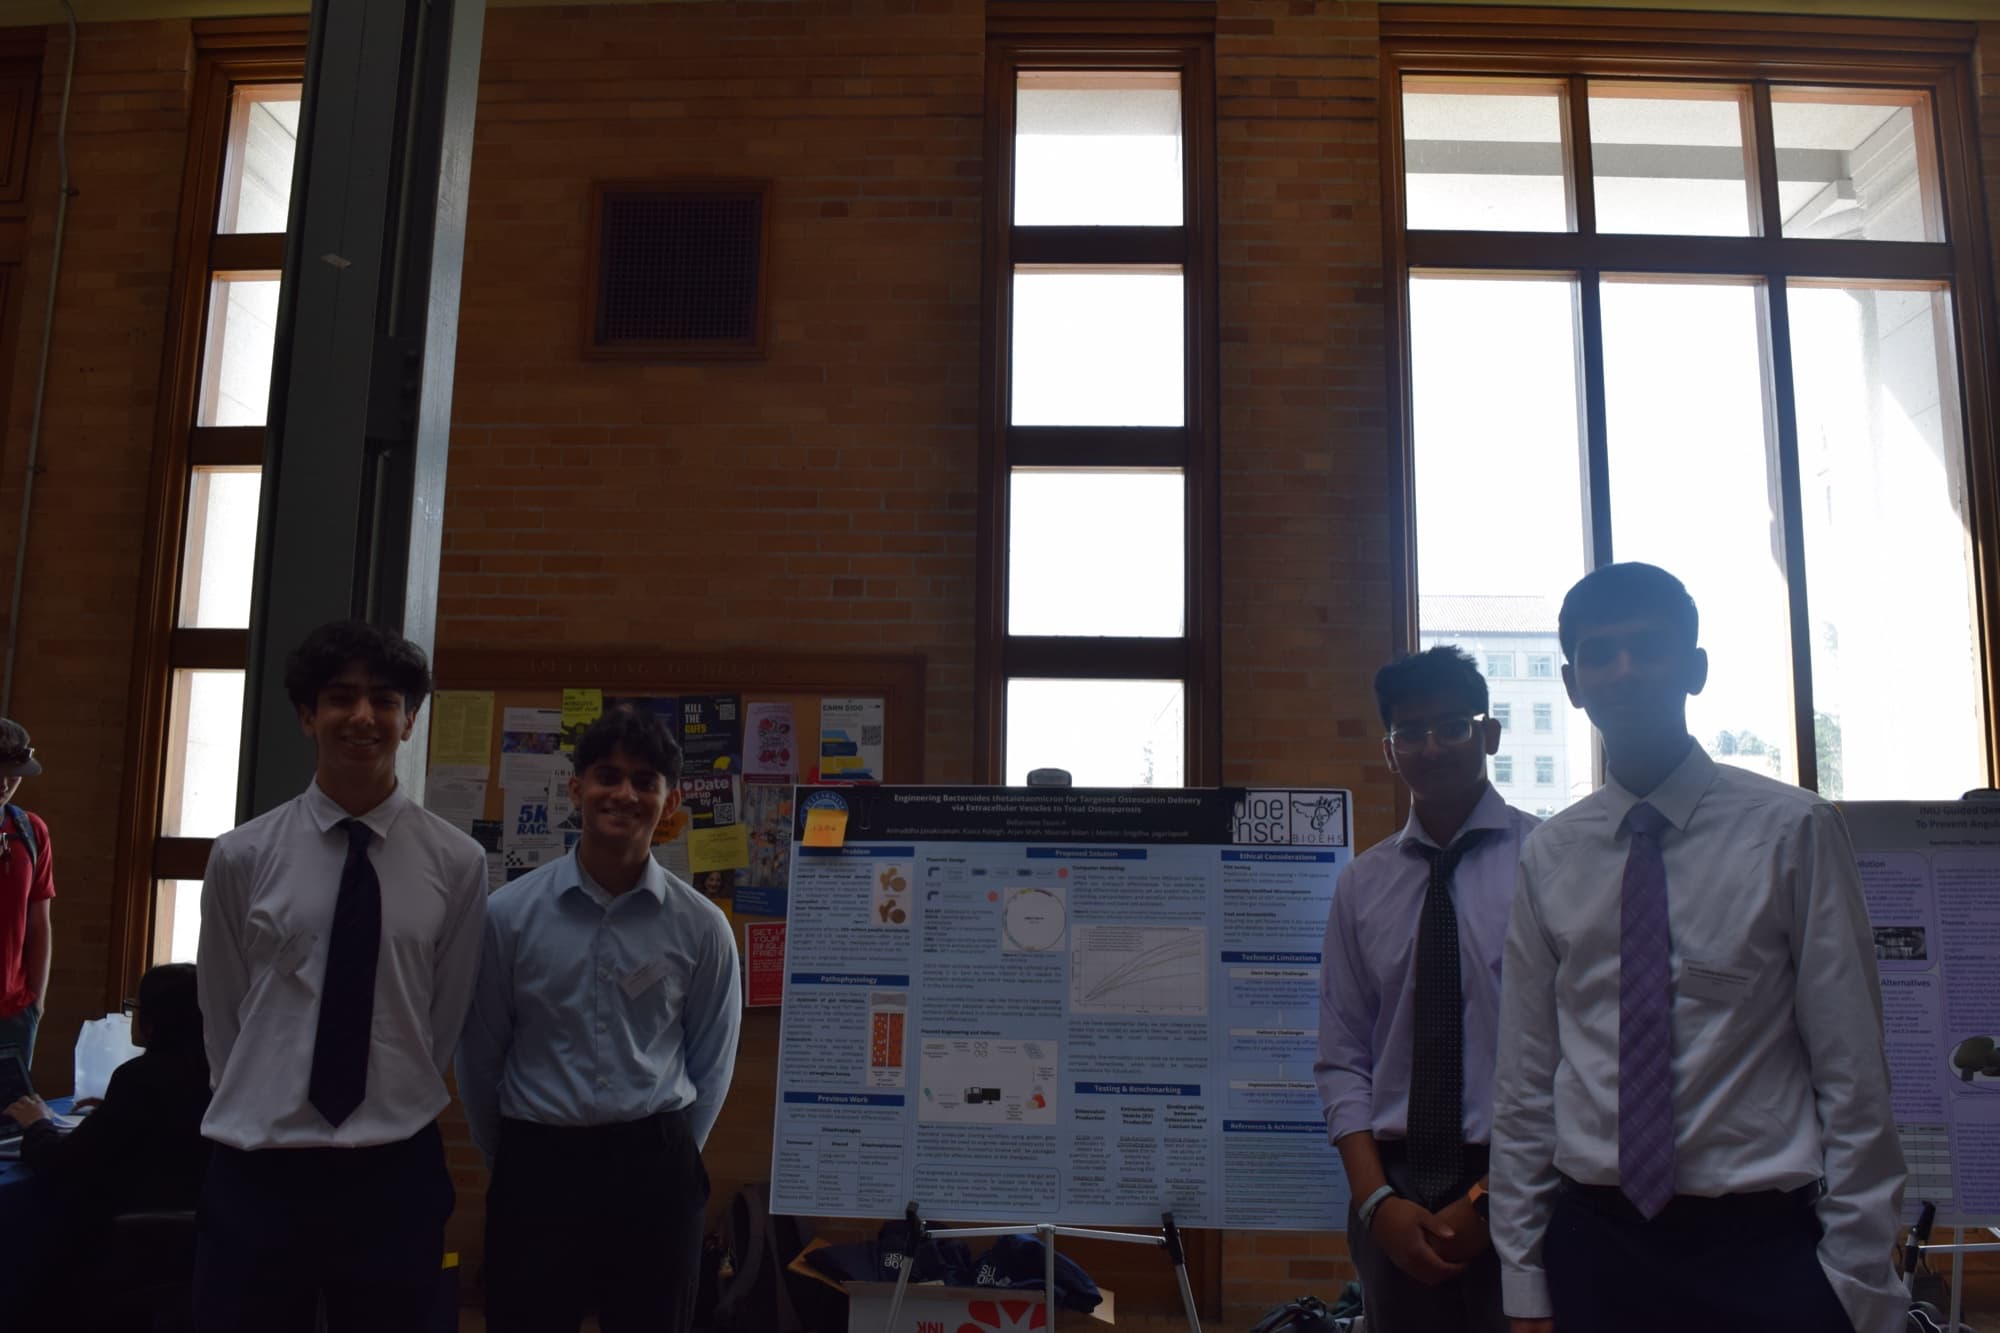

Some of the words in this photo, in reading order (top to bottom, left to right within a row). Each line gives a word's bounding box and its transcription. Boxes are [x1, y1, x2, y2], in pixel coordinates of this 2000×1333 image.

[685, 703, 703, 713] KILL
[685, 714, 702, 723] THE
[694, 778, 729, 791] Date
[894, 794, 942, 804] Engineering
[943, 794, 990, 803] Bacteroides
[1066, 795, 1078, 803] for
[1080, 796, 1116, 805] Targeted
[1118, 796, 1166, 804] Osteocalcin
[1168, 797, 1202, 806] Delivery
[518, 804, 549, 823] 5K
[952, 804, 964, 812] via
[966, 804, 1018, 812] Extracellular
[1019, 805, 1052, 813] Vesicles
[1064, 805, 1086, 813] Treat
[1088, 805, 1142, 815] Osteoporosis
[1943, 806, 1978, 815] Guided
[1915, 819, 1928, 829] To
[1929, 819, 1967, 829] Prevent
[842, 848, 871, 856] Problem
[1055, 849, 1087, 859] Proposed
[1088, 850, 1119, 858] Solution
[1240, 852, 1263, 861] Ethical
[1264, 853, 1317, 862] Considerations
[1241, 952, 1275, 961] Technical
[1276, 953, 1317, 962] Limitations
[820, 976, 878, 985] Pathophysiology
[1881, 978, 1931, 987] Alternatives
[1093, 1084, 1120, 1093] Testing
[1122, 1085, 1128, 1093] &
[1129, 1085, 1182, 1095] Benchmarking
[817, 1095, 848, 1103] Previous
[849, 1095, 869, 1104] Work
[1230, 1123, 1266, 1131] References
[916, 1320, 944, 1333] INK
